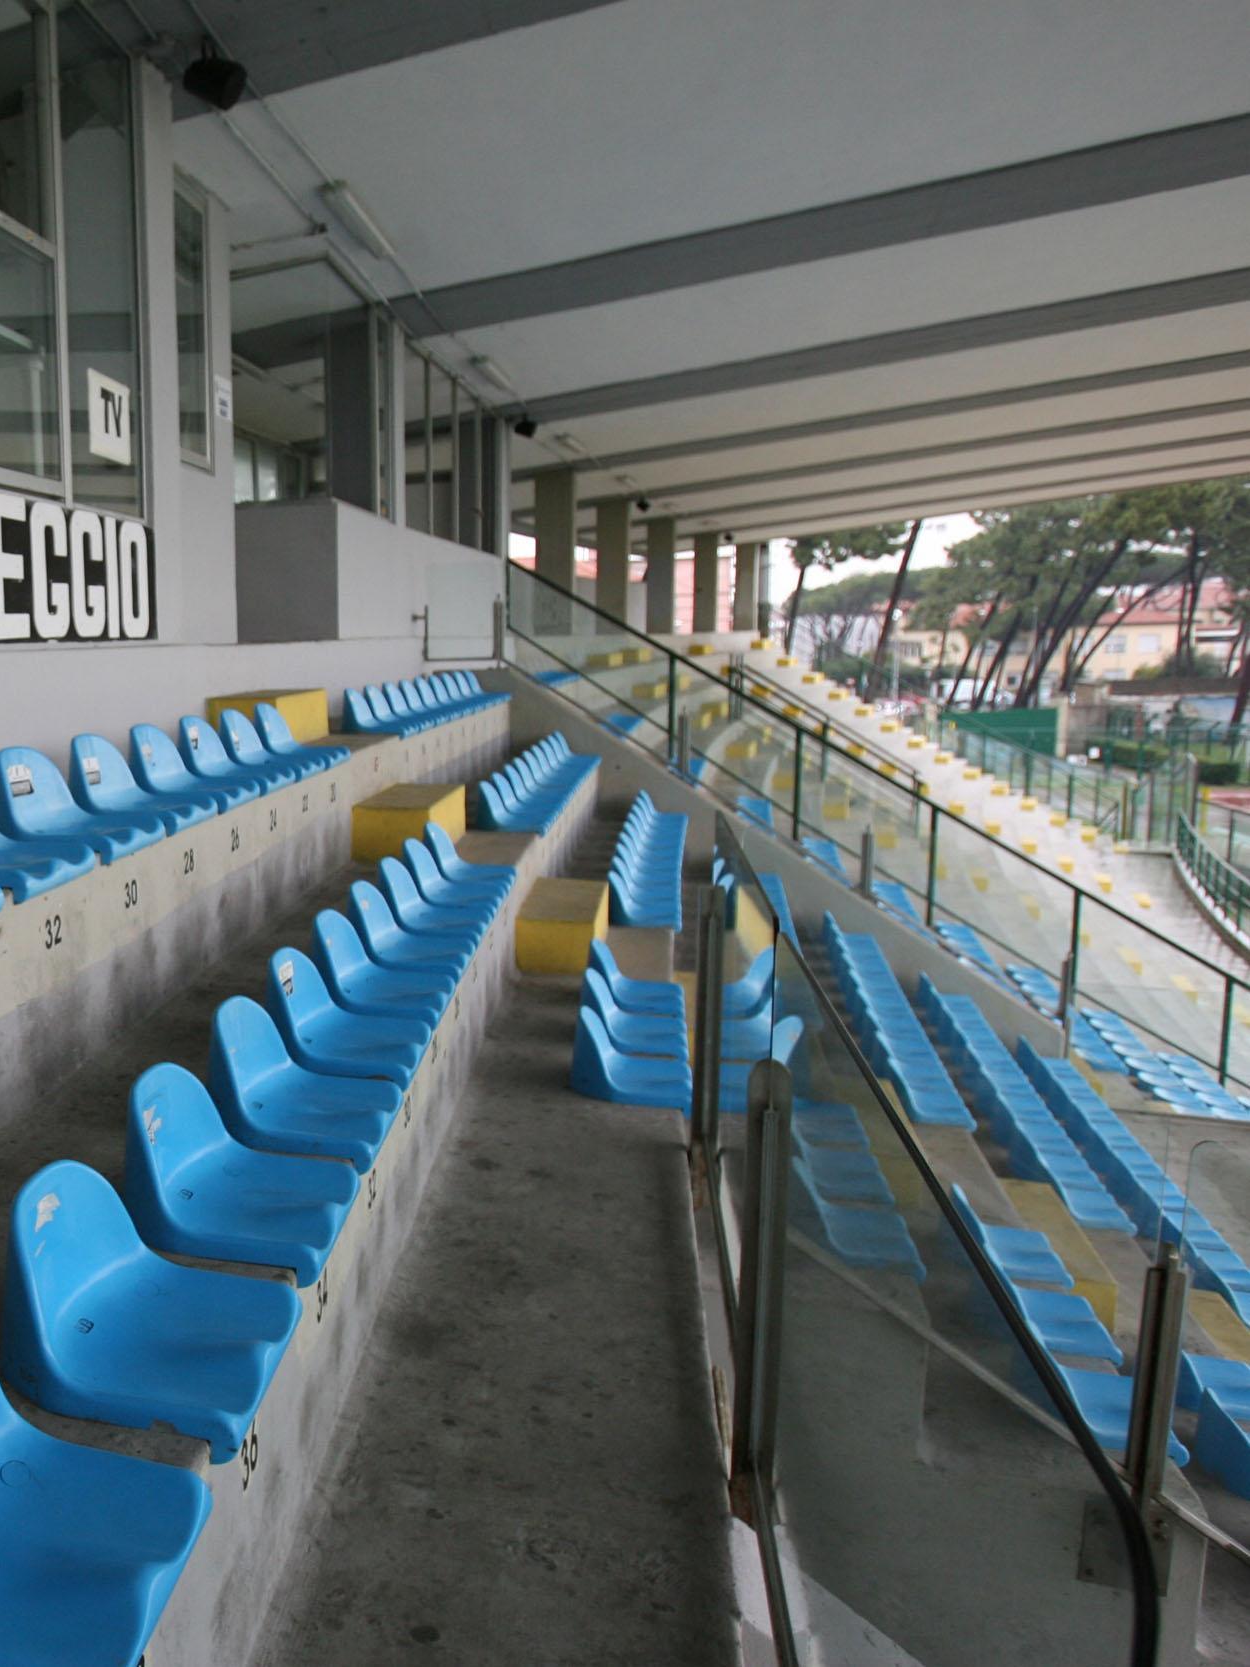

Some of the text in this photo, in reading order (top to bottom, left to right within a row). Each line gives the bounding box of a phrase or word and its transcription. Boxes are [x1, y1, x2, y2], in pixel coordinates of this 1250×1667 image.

[100, 386, 123, 438] TV
[269, 808, 278, 832] 24
[230, 827, 240, 852] 26
[183, 848, 195, 875] 28
[124, 879, 138, 909] 30
[45, 915, 62, 950] 32
[316, 1266, 328, 1324] 34
[241, 1417, 259, 1492] 36
